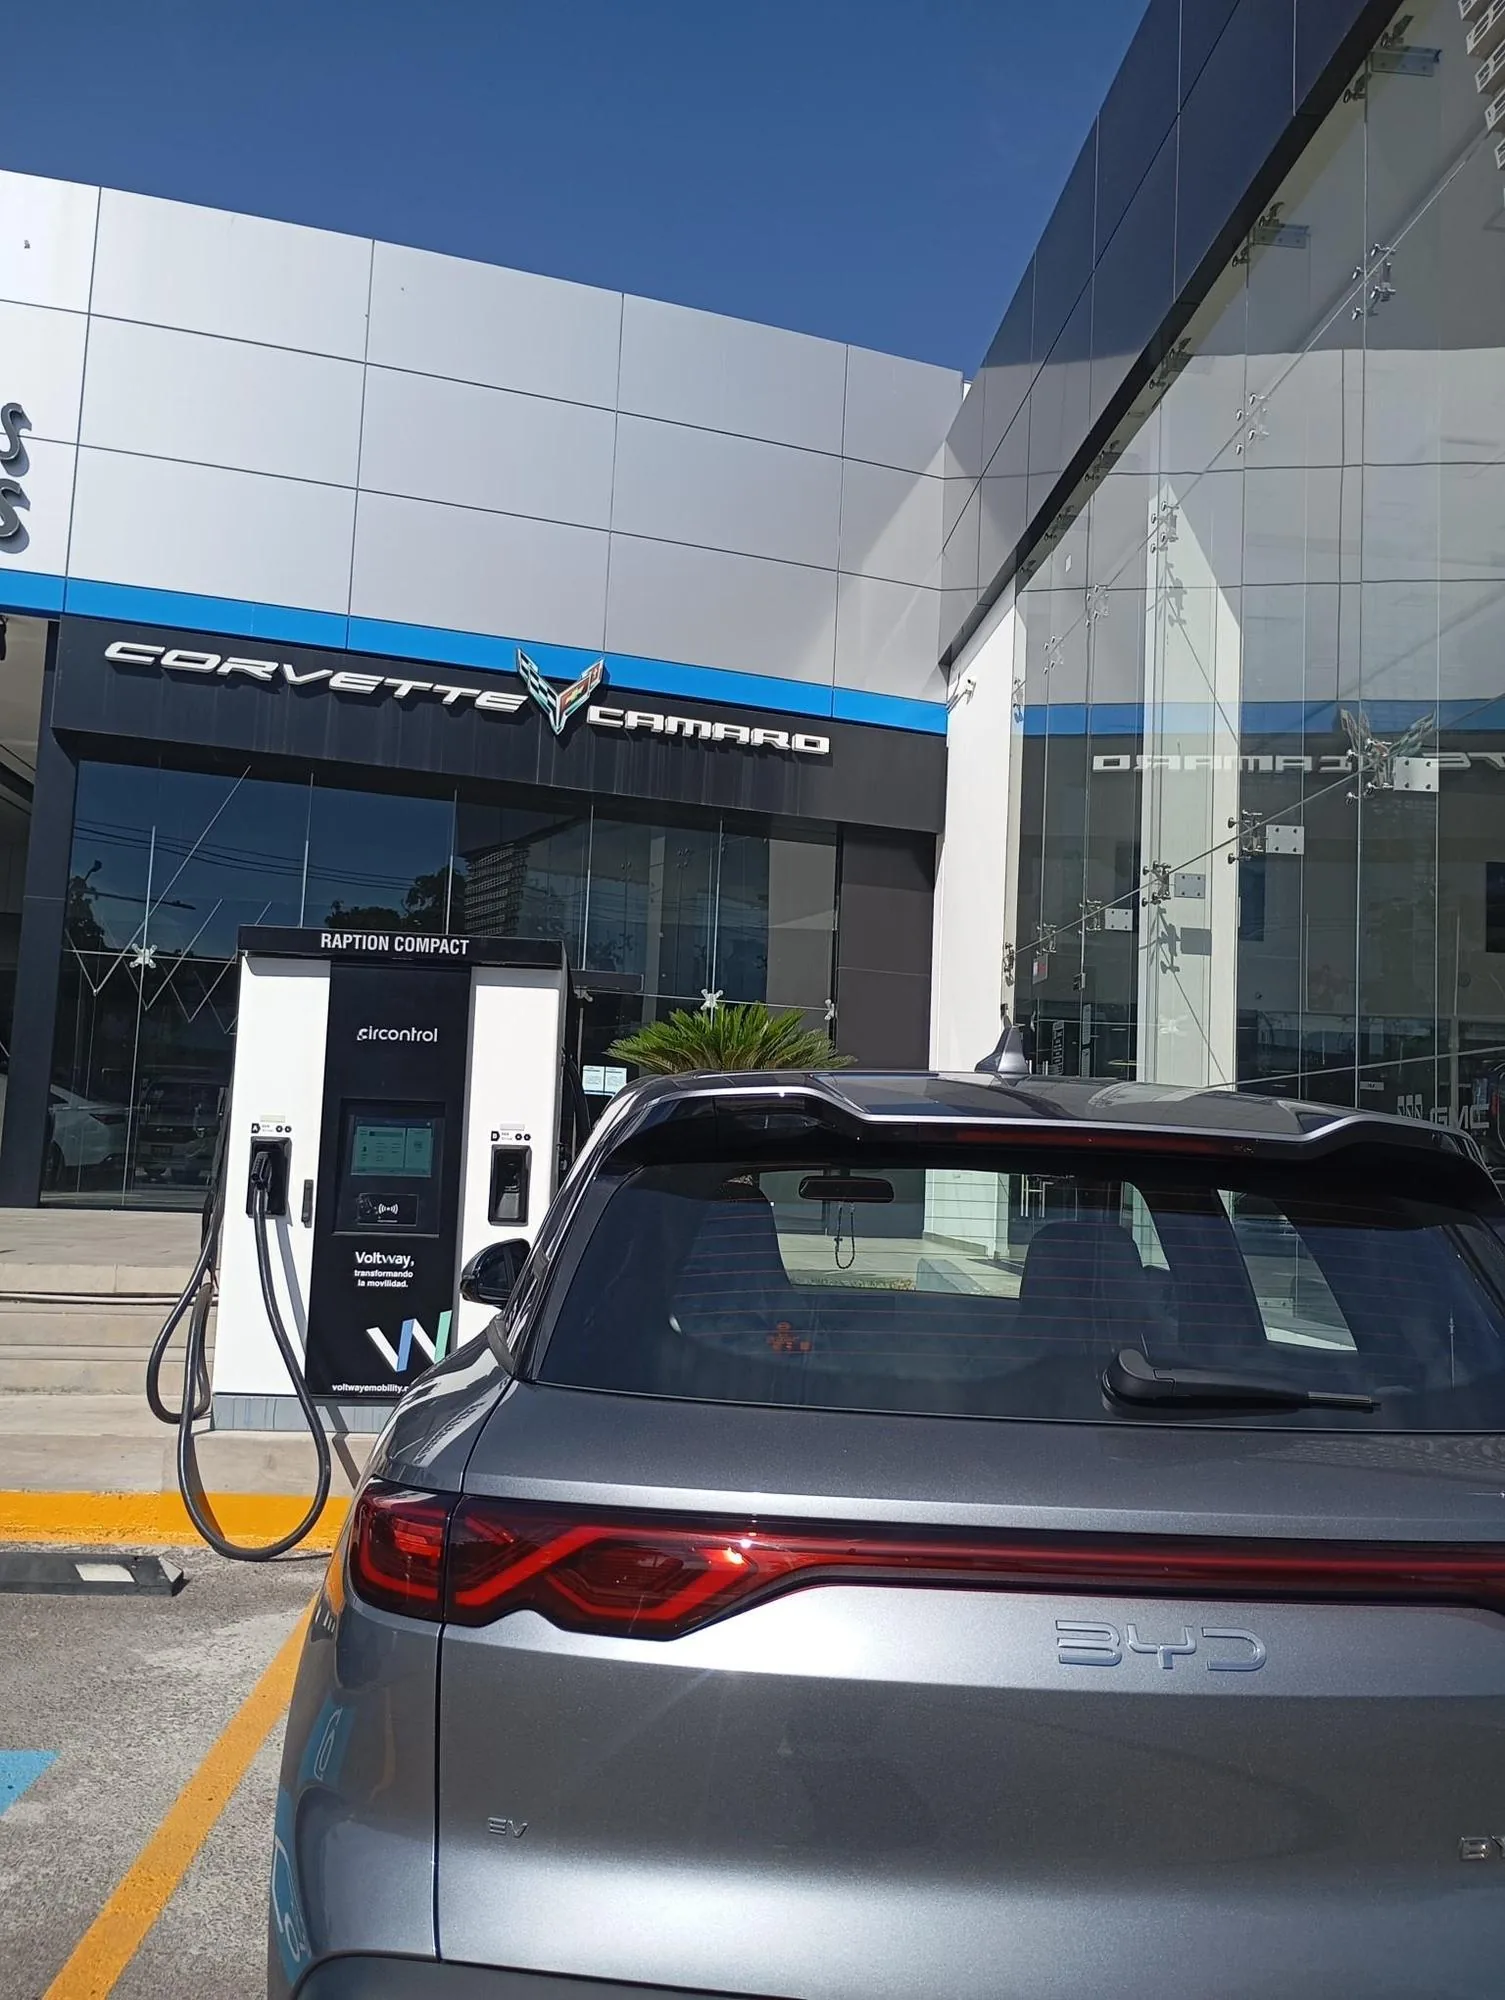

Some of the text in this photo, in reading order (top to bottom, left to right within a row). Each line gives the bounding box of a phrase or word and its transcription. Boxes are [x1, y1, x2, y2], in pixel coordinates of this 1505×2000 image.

[104, 640, 830, 755] CORVETTE CAMARO
[321, 933, 469, 955] RAPTION COMPACT
[356, 1025, 438, 1042] circontrol
[355, 1251, 415, 1268] Voltway,
[354, 1269, 414, 1278] transformando
[1056, 1620, 1266, 1671] BYD
[488, 1816, 528, 1838] EV
